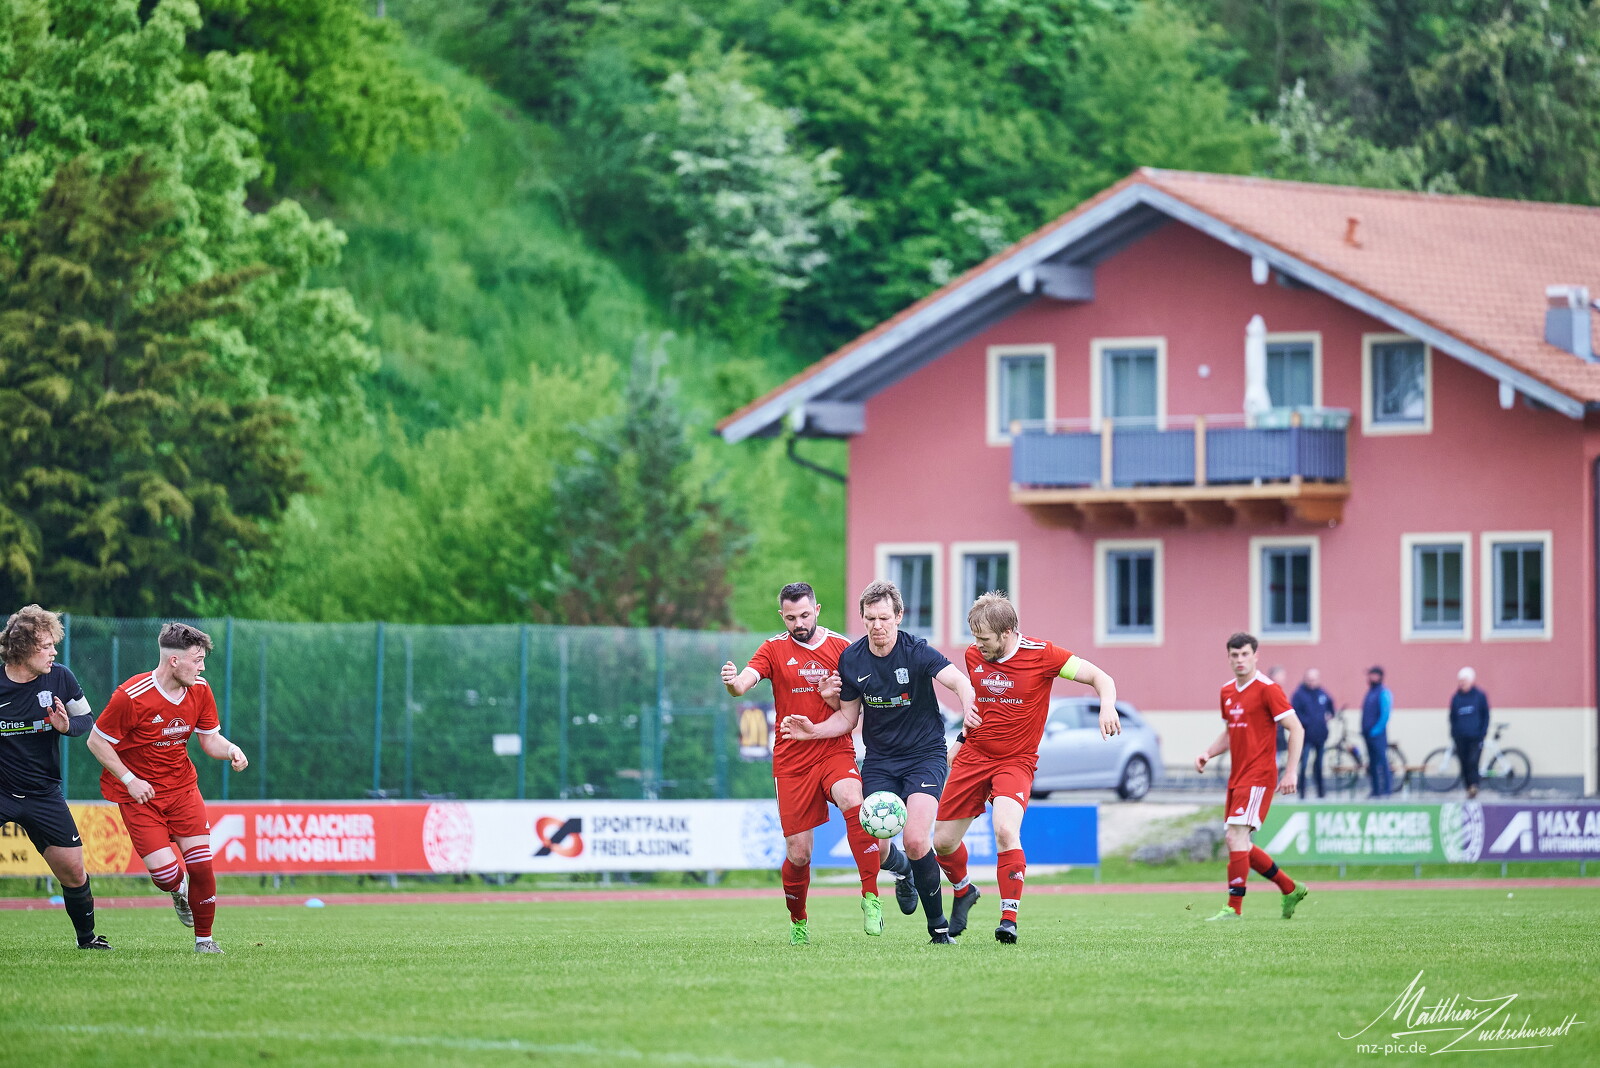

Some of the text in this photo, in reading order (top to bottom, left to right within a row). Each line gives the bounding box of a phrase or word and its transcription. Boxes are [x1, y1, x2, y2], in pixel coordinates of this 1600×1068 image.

[0, 720, 25, 730] Gries
[255, 814, 375, 837] MAX AICHER
[591, 815, 690, 833] SPORTPARK
[1315, 811, 1362, 836] MAX
[1364, 811, 1431, 836] AICHER
[1537, 811, 1582, 836] MAX
[256, 838, 376, 862] IMMOBILIEN
[591, 838, 691, 856] FREILASSING
